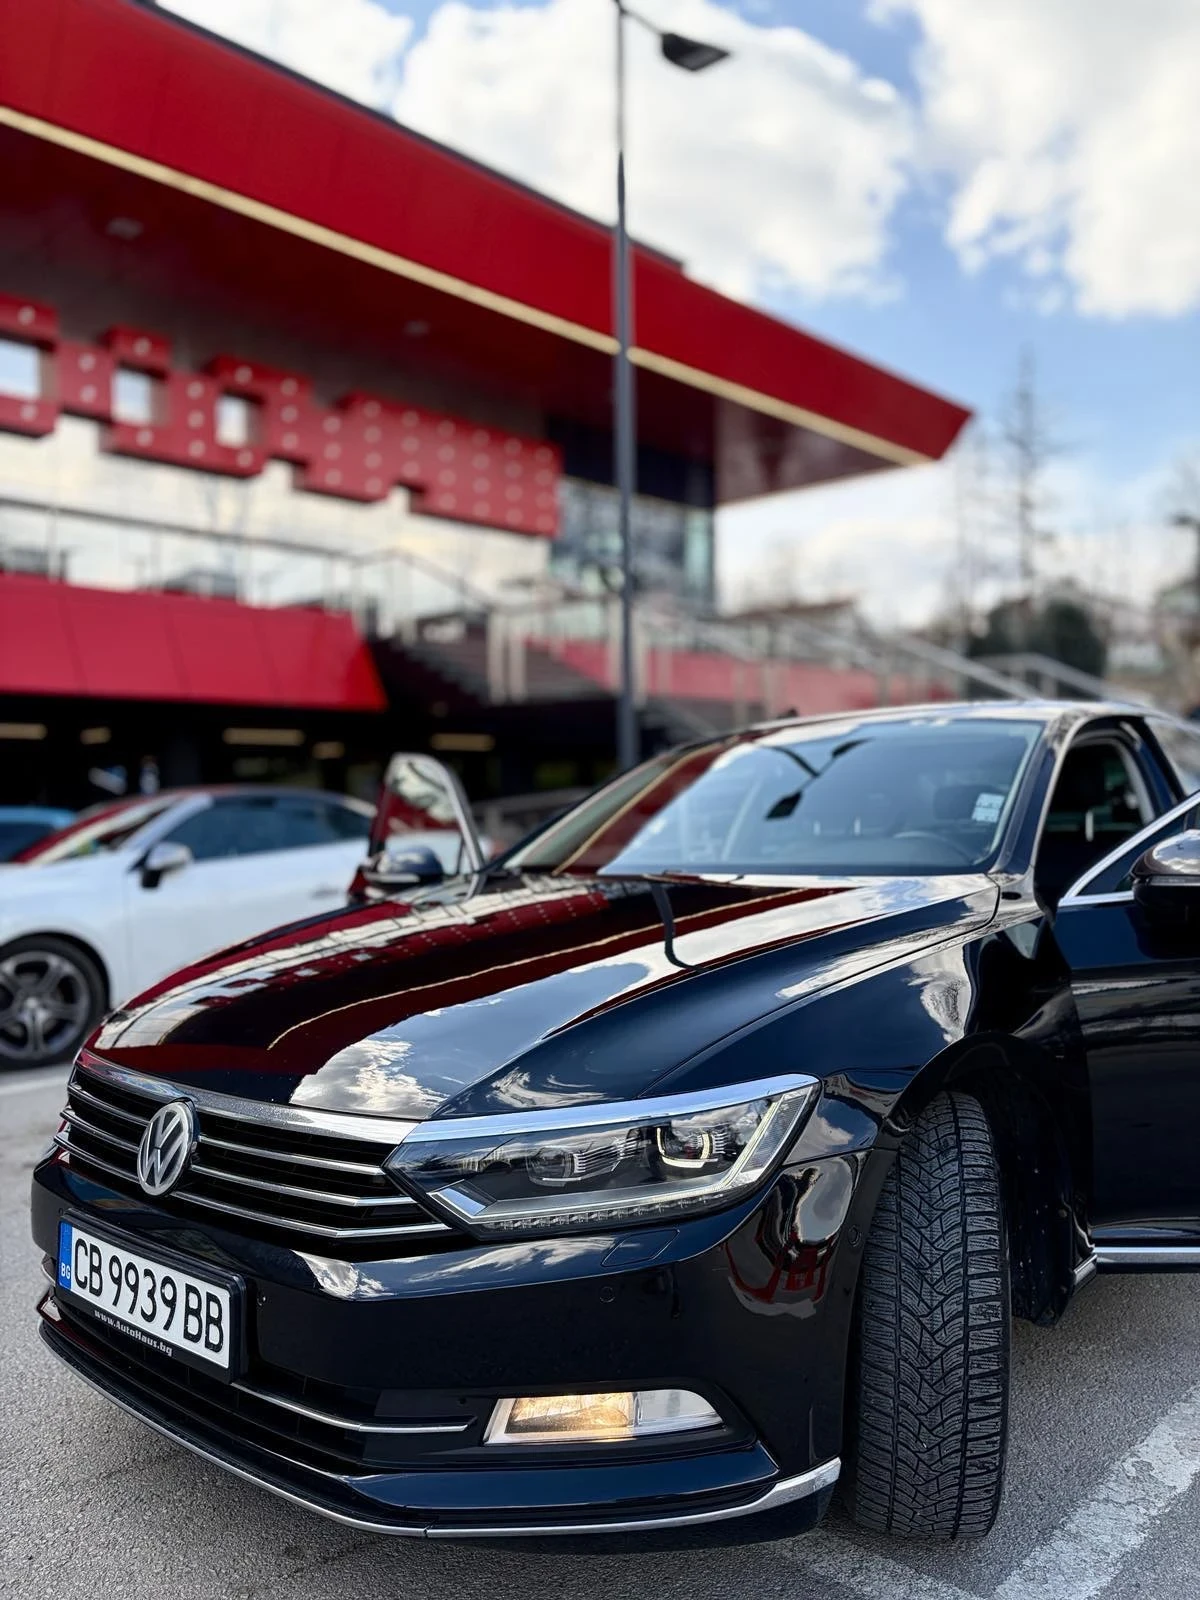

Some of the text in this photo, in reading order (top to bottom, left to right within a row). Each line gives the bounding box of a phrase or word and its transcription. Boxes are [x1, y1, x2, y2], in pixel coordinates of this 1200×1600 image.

[139, 1103, 192, 1194] VW
[61, 1263, 71, 1280] BG
[94, 1309, 173, 1357] www.AutoHaus.bg
